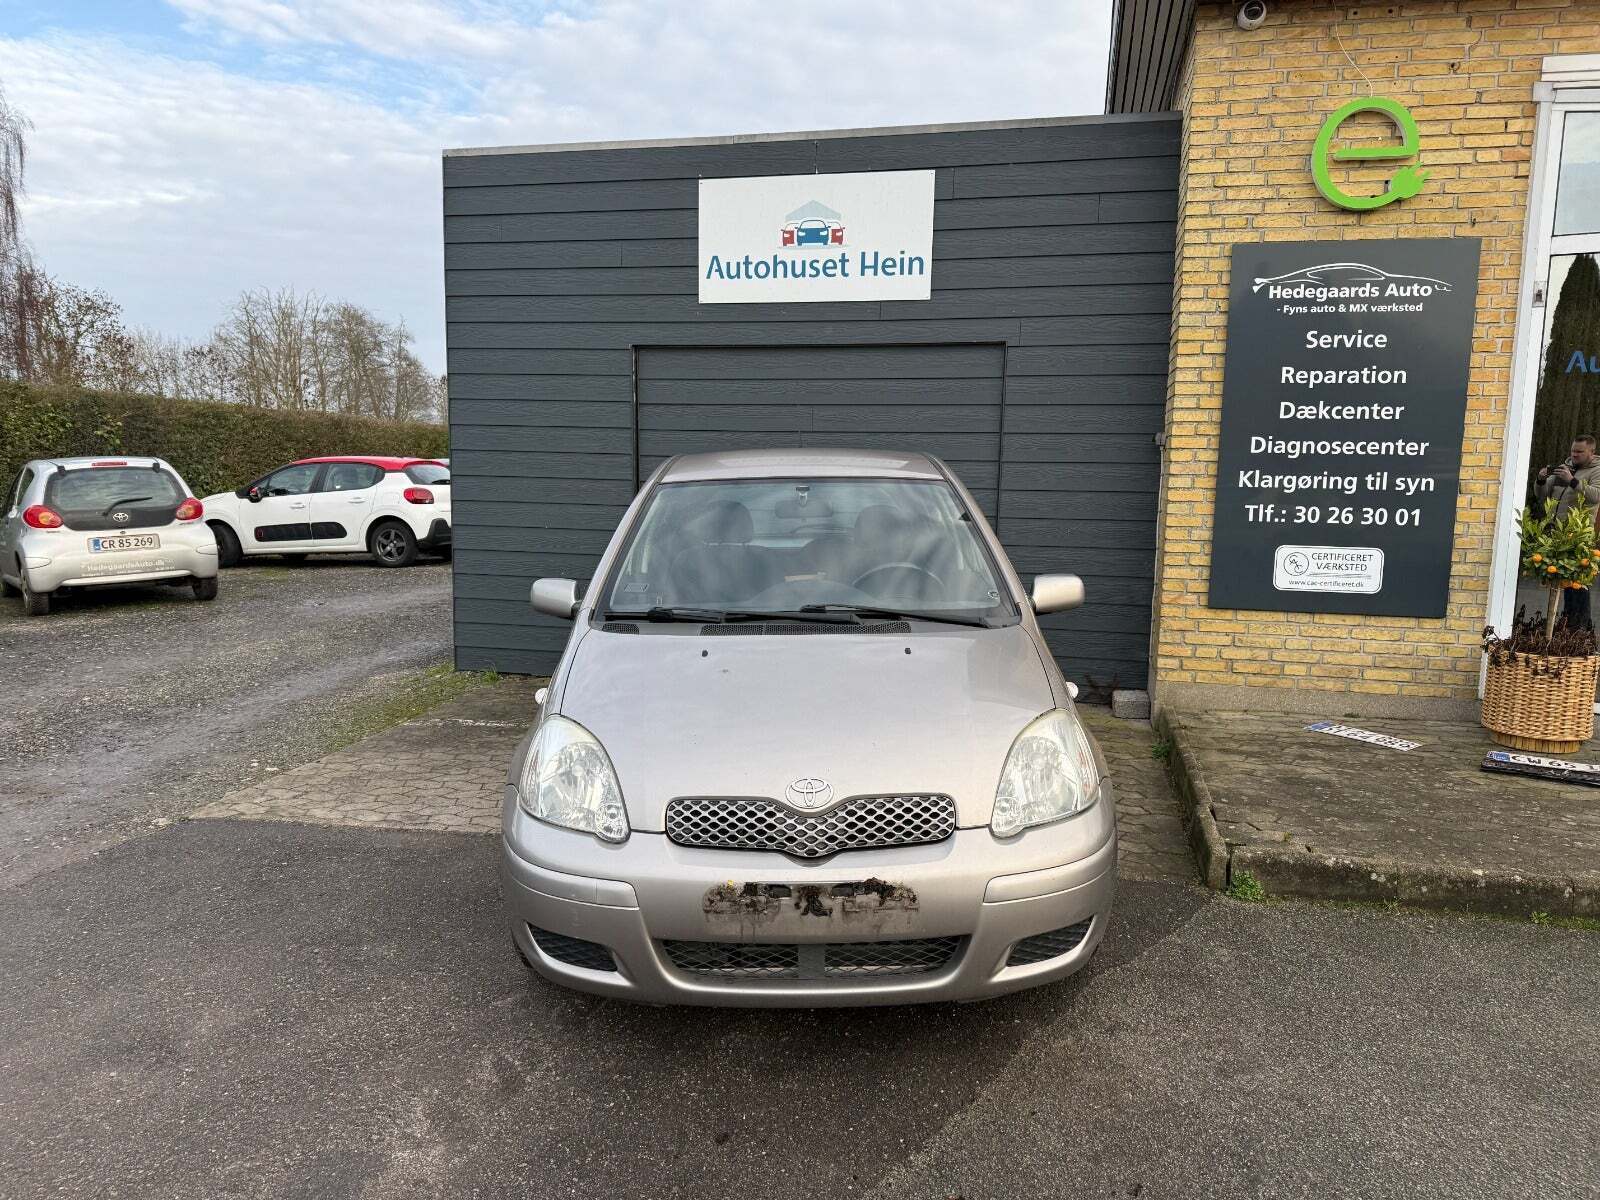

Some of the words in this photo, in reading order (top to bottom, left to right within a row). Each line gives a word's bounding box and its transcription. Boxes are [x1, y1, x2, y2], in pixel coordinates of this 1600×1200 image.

[705, 252, 849, 280] Autohuset
[860, 250, 925, 277] Hein
[1268, 282, 1380, 302] Hedegaards
[1384, 282, 1433, 298] Auto
[1283, 304, 1308, 316] Fyns
[1310, 303, 1336, 313] auto
[1338, 303, 1347, 313] &
[1349, 303, 1368, 313] MX
[1370, 302, 1424, 313] værksted
[1305, 329, 1388, 349] Service
[1280, 365, 1408, 388] Reparation
[1279, 400, 1405, 420] Dækcenter
[1250, 436, 1430, 459] Diagnosecenter
[1238, 470, 1358, 494] Klargøring
[1364, 472, 1389, 491] til
[1395, 476, 1435, 496] syn
[1244, 504, 1287, 523] Tlf.:
[1293, 505, 1321, 524] 30
[1326, 507, 1354, 525] 26
[1360, 507, 1388, 526] 30
[1394, 508, 1422, 527] 01
[101, 539, 116, 549] CR
[118, 538, 131, 548] 85
[134, 536, 153, 547] 269
[1311, 552, 1374, 562] CERTIFICERET
[1316, 562, 1368, 572] VÆRKSTED
[1288, 580, 1364, 588] www.cac-certificeret.dk
